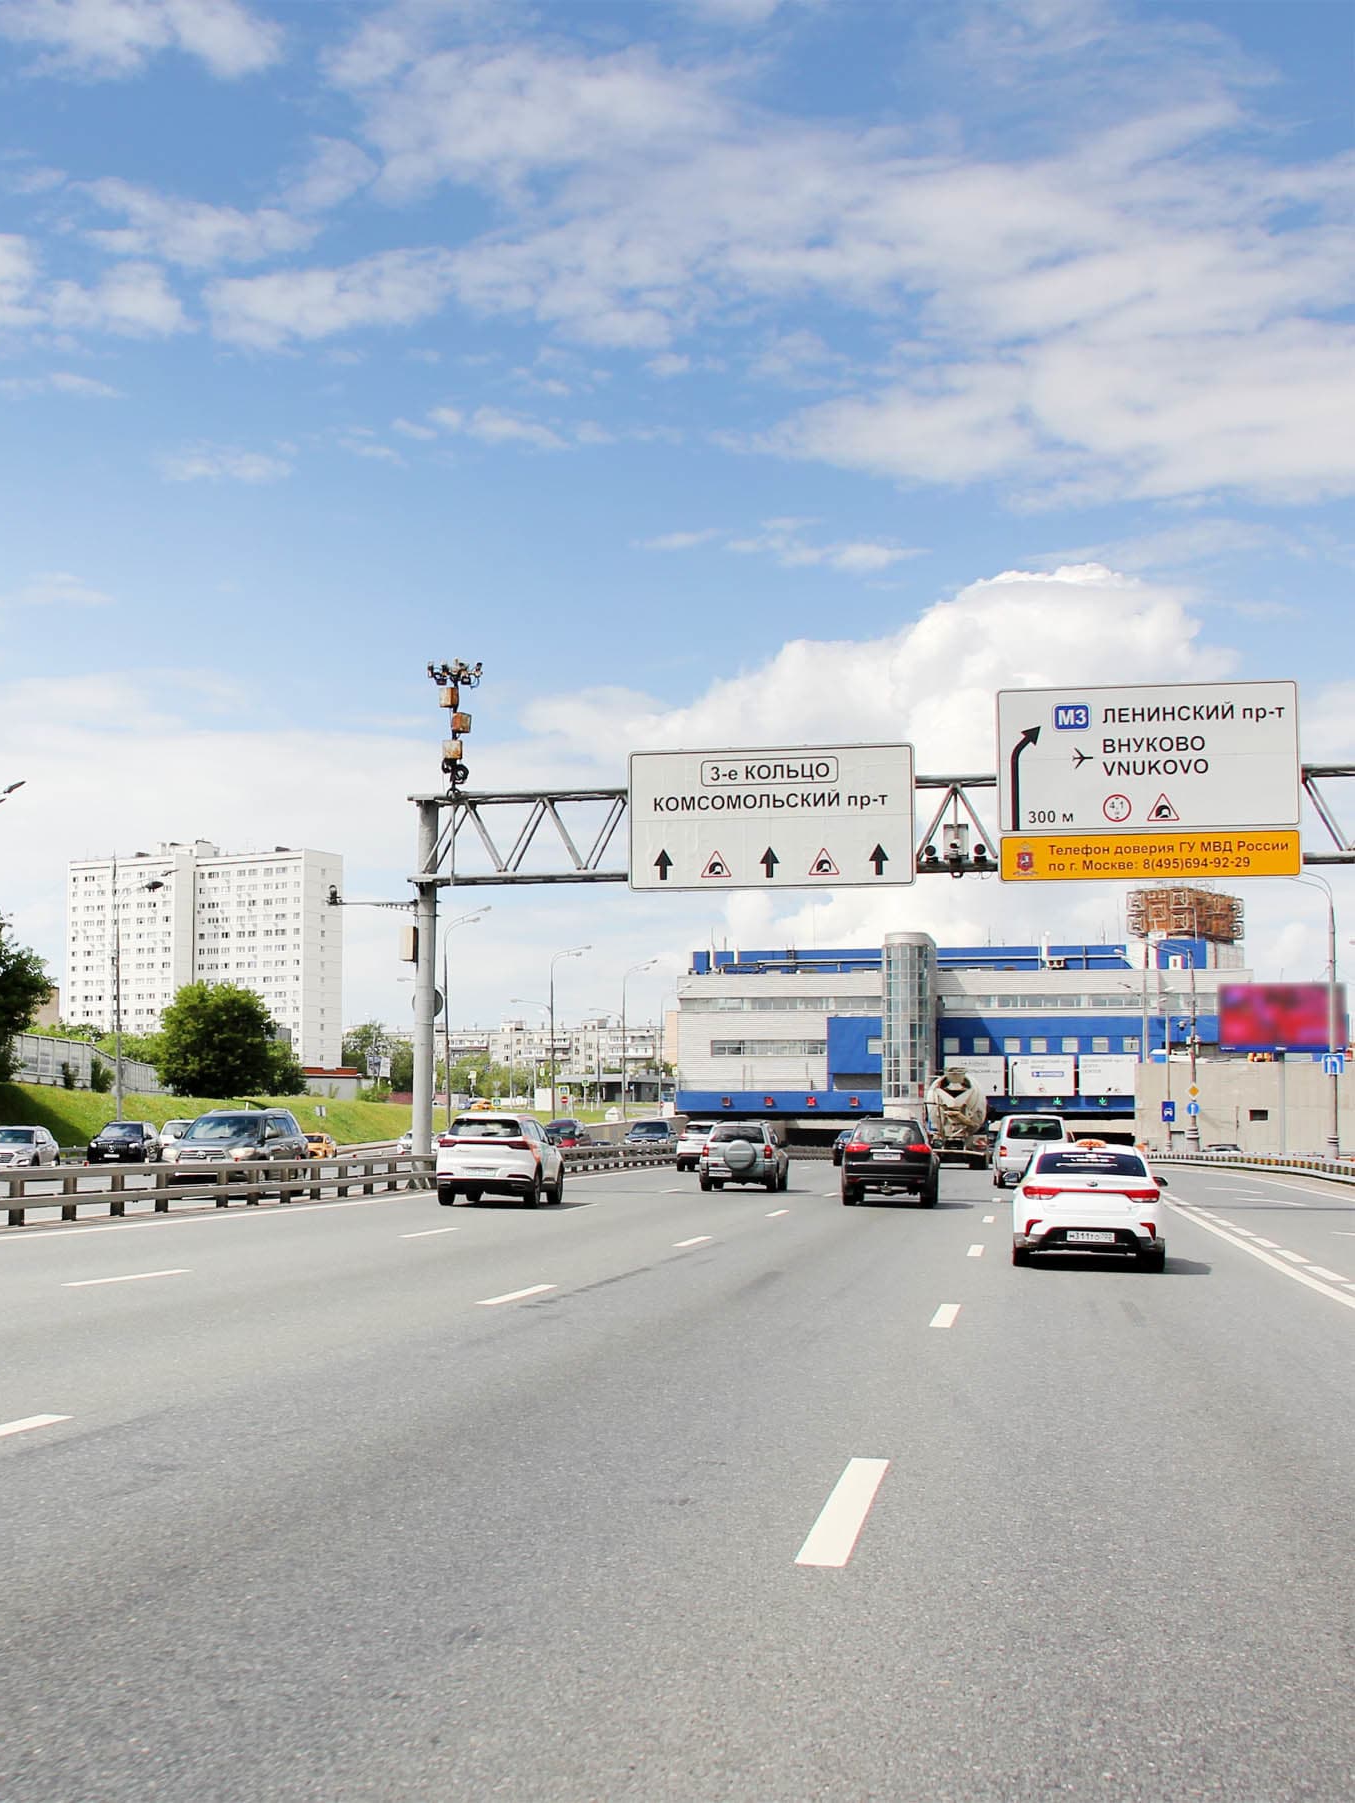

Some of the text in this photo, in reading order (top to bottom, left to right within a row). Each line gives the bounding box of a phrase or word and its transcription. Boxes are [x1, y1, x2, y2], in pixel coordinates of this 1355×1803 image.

[1058, 702, 1285, 726] М3 ЛЕНИНСКИЙ пр-т
[1103, 736, 1205, 754] ВНУКОВО
[711, 762, 830, 782] 3-е КОЛЬЦО
[1103, 758, 1208, 776] VNUKOVO
[654, 788, 888, 811] КОМСОМОЛЬСКИЙ пр-т
[1029, 810, 1074, 823] 300 м
[1048, 840, 1289, 857] Телефон доверия ГУ МВД России
[1048, 856, 1251, 872] по г. Москве: 8(495)694-92-29
